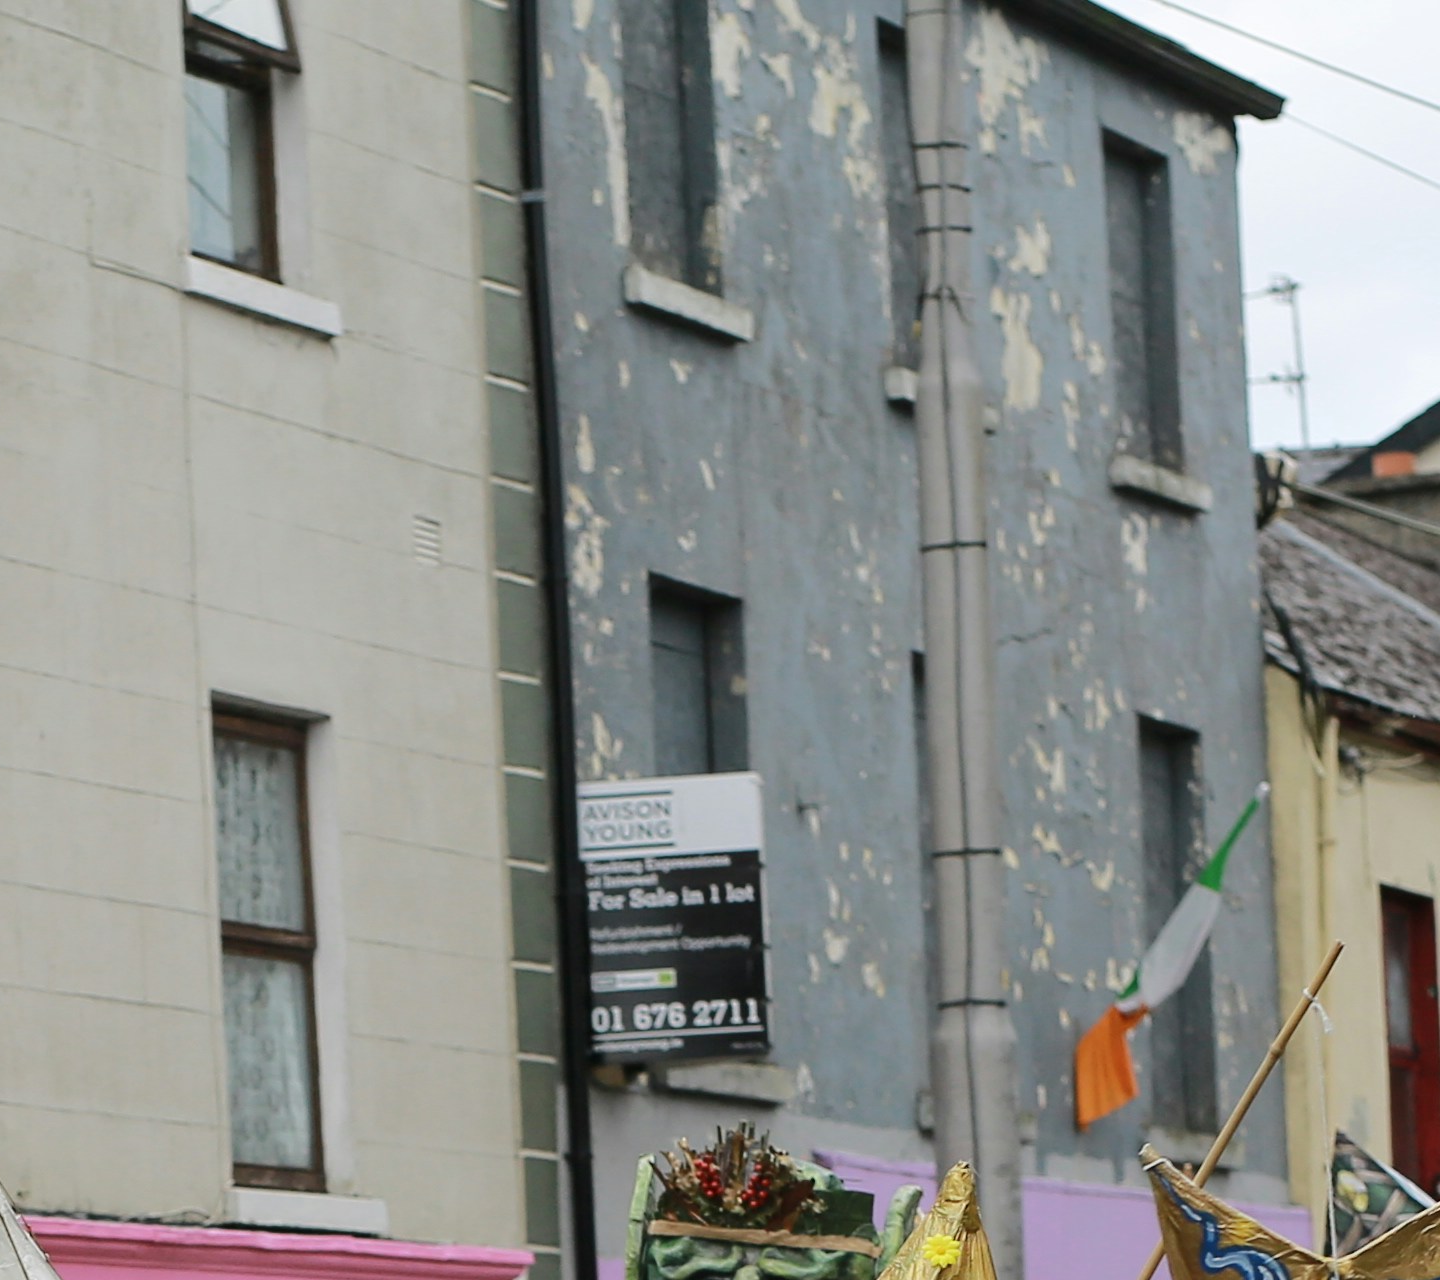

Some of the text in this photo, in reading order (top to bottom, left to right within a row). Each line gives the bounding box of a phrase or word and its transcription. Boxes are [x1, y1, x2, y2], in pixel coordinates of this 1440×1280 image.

[583, 799, 673, 821] AVISON
[583, 820, 673, 843] YOUNG
[588, 890, 625, 911] For
[628, 887, 679, 909] Sale
[682, 885, 704, 906] in
[725, 882, 755, 903] lot
[591, 998, 761, 1033] 01 676 2711
